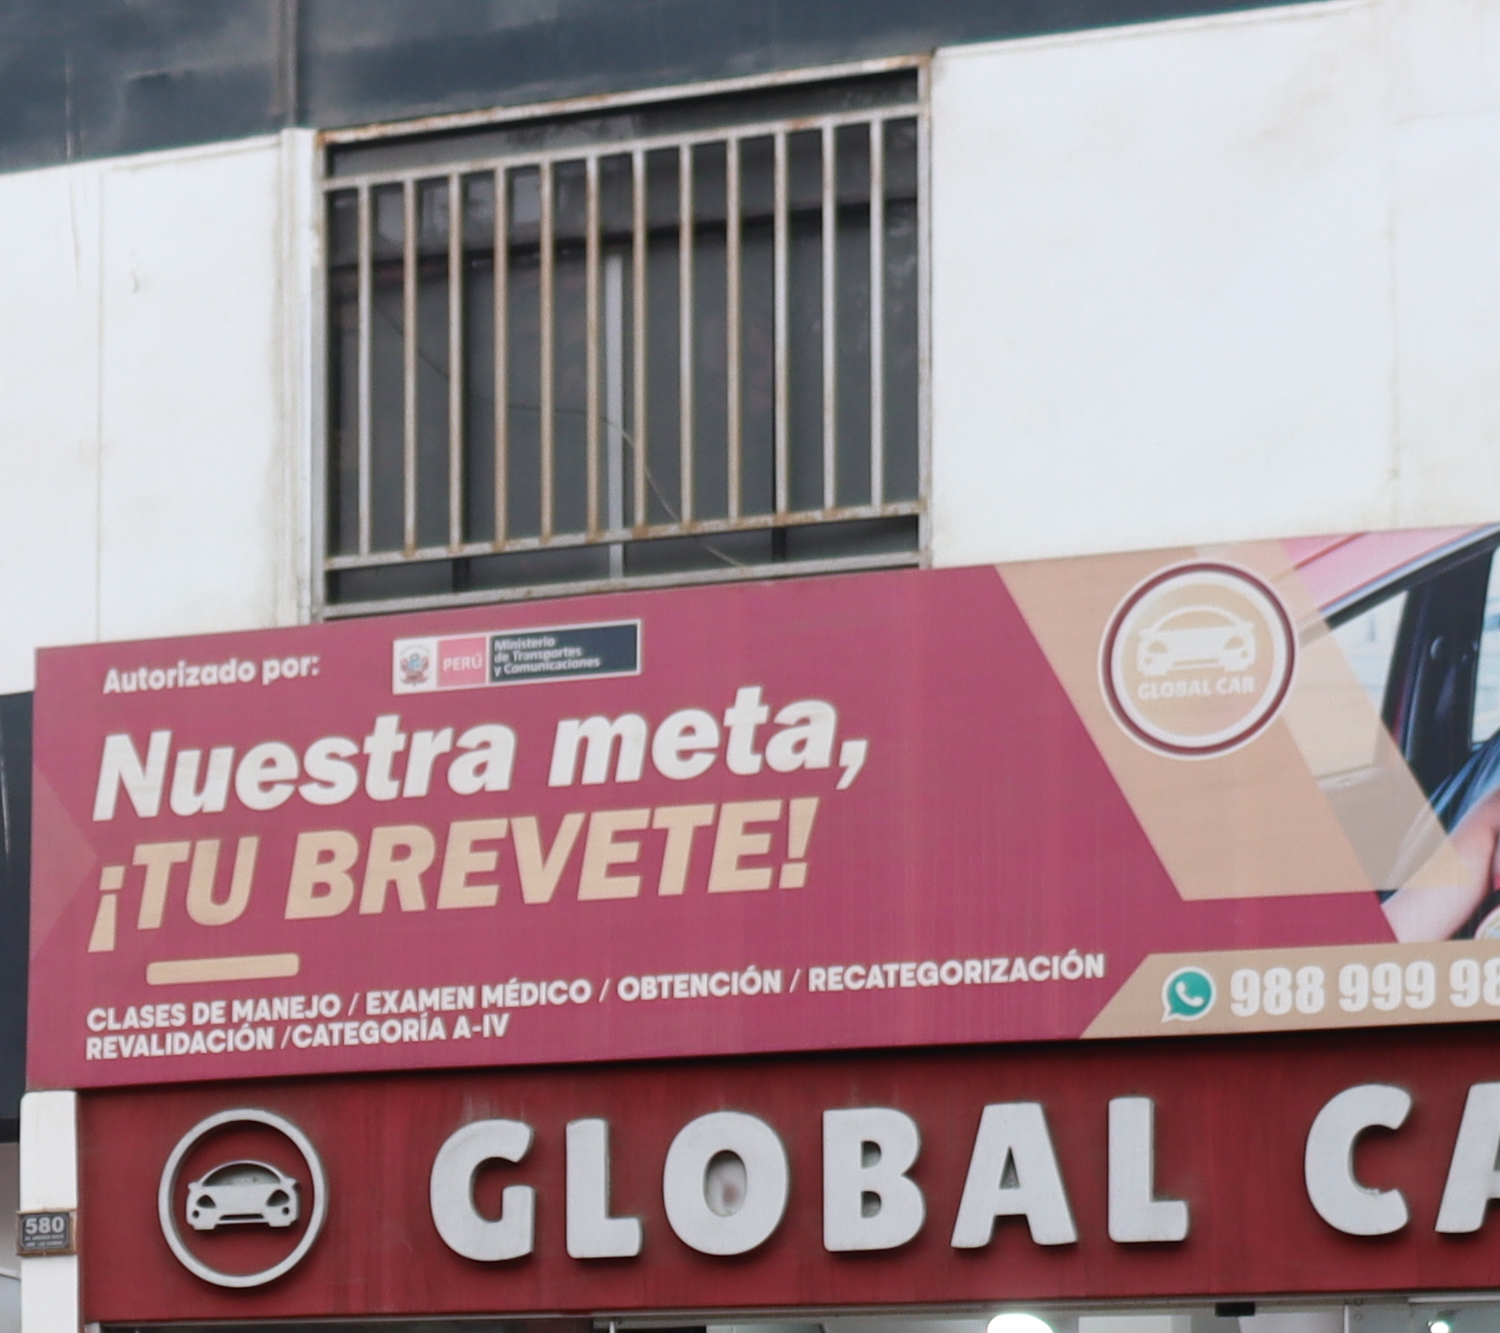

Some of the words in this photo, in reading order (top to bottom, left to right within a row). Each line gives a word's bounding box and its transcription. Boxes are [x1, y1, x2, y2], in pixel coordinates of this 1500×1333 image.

[442, 652, 483, 673] PERÚ
[493, 635, 556, 652] Ministerio
[503, 654, 601, 675] Comunicaciones
[511, 645, 582, 664] Transportes
[102, 658, 255, 695] Autorizado
[262, 653, 320, 686] por:
[1136, 679, 1210, 702] GLOBAL
[1215, 677, 1256, 697] CAR
[92, 714, 517, 822] Nuestra
[548, 686, 869, 790] meta,
[87, 836, 260, 953] ¡TU
[284, 797, 819, 920] BREVETE!
[86, 1001, 187, 1032] CLASES
[192, 1000, 226, 1026] DE
[232, 992, 341, 1023] MANEJO
[365, 984, 476, 1016] EXAMEN
[481, 977, 592, 1008] MÉDICO
[616, 965, 782, 1002] OBTENCIÓN
[808, 948, 1105, 992] RECATEGORIZACIÓN
[1229, 966, 1326, 1019] 988
[1338, 961, 1435, 1012] 999
[85, 1024, 274, 1061] REVALIDACIÓN
[452, 1013, 511, 1040] A-IV
[428, 1096, 1191, 1263] GLOBAL
[25, 1216, 65, 1235] 580
